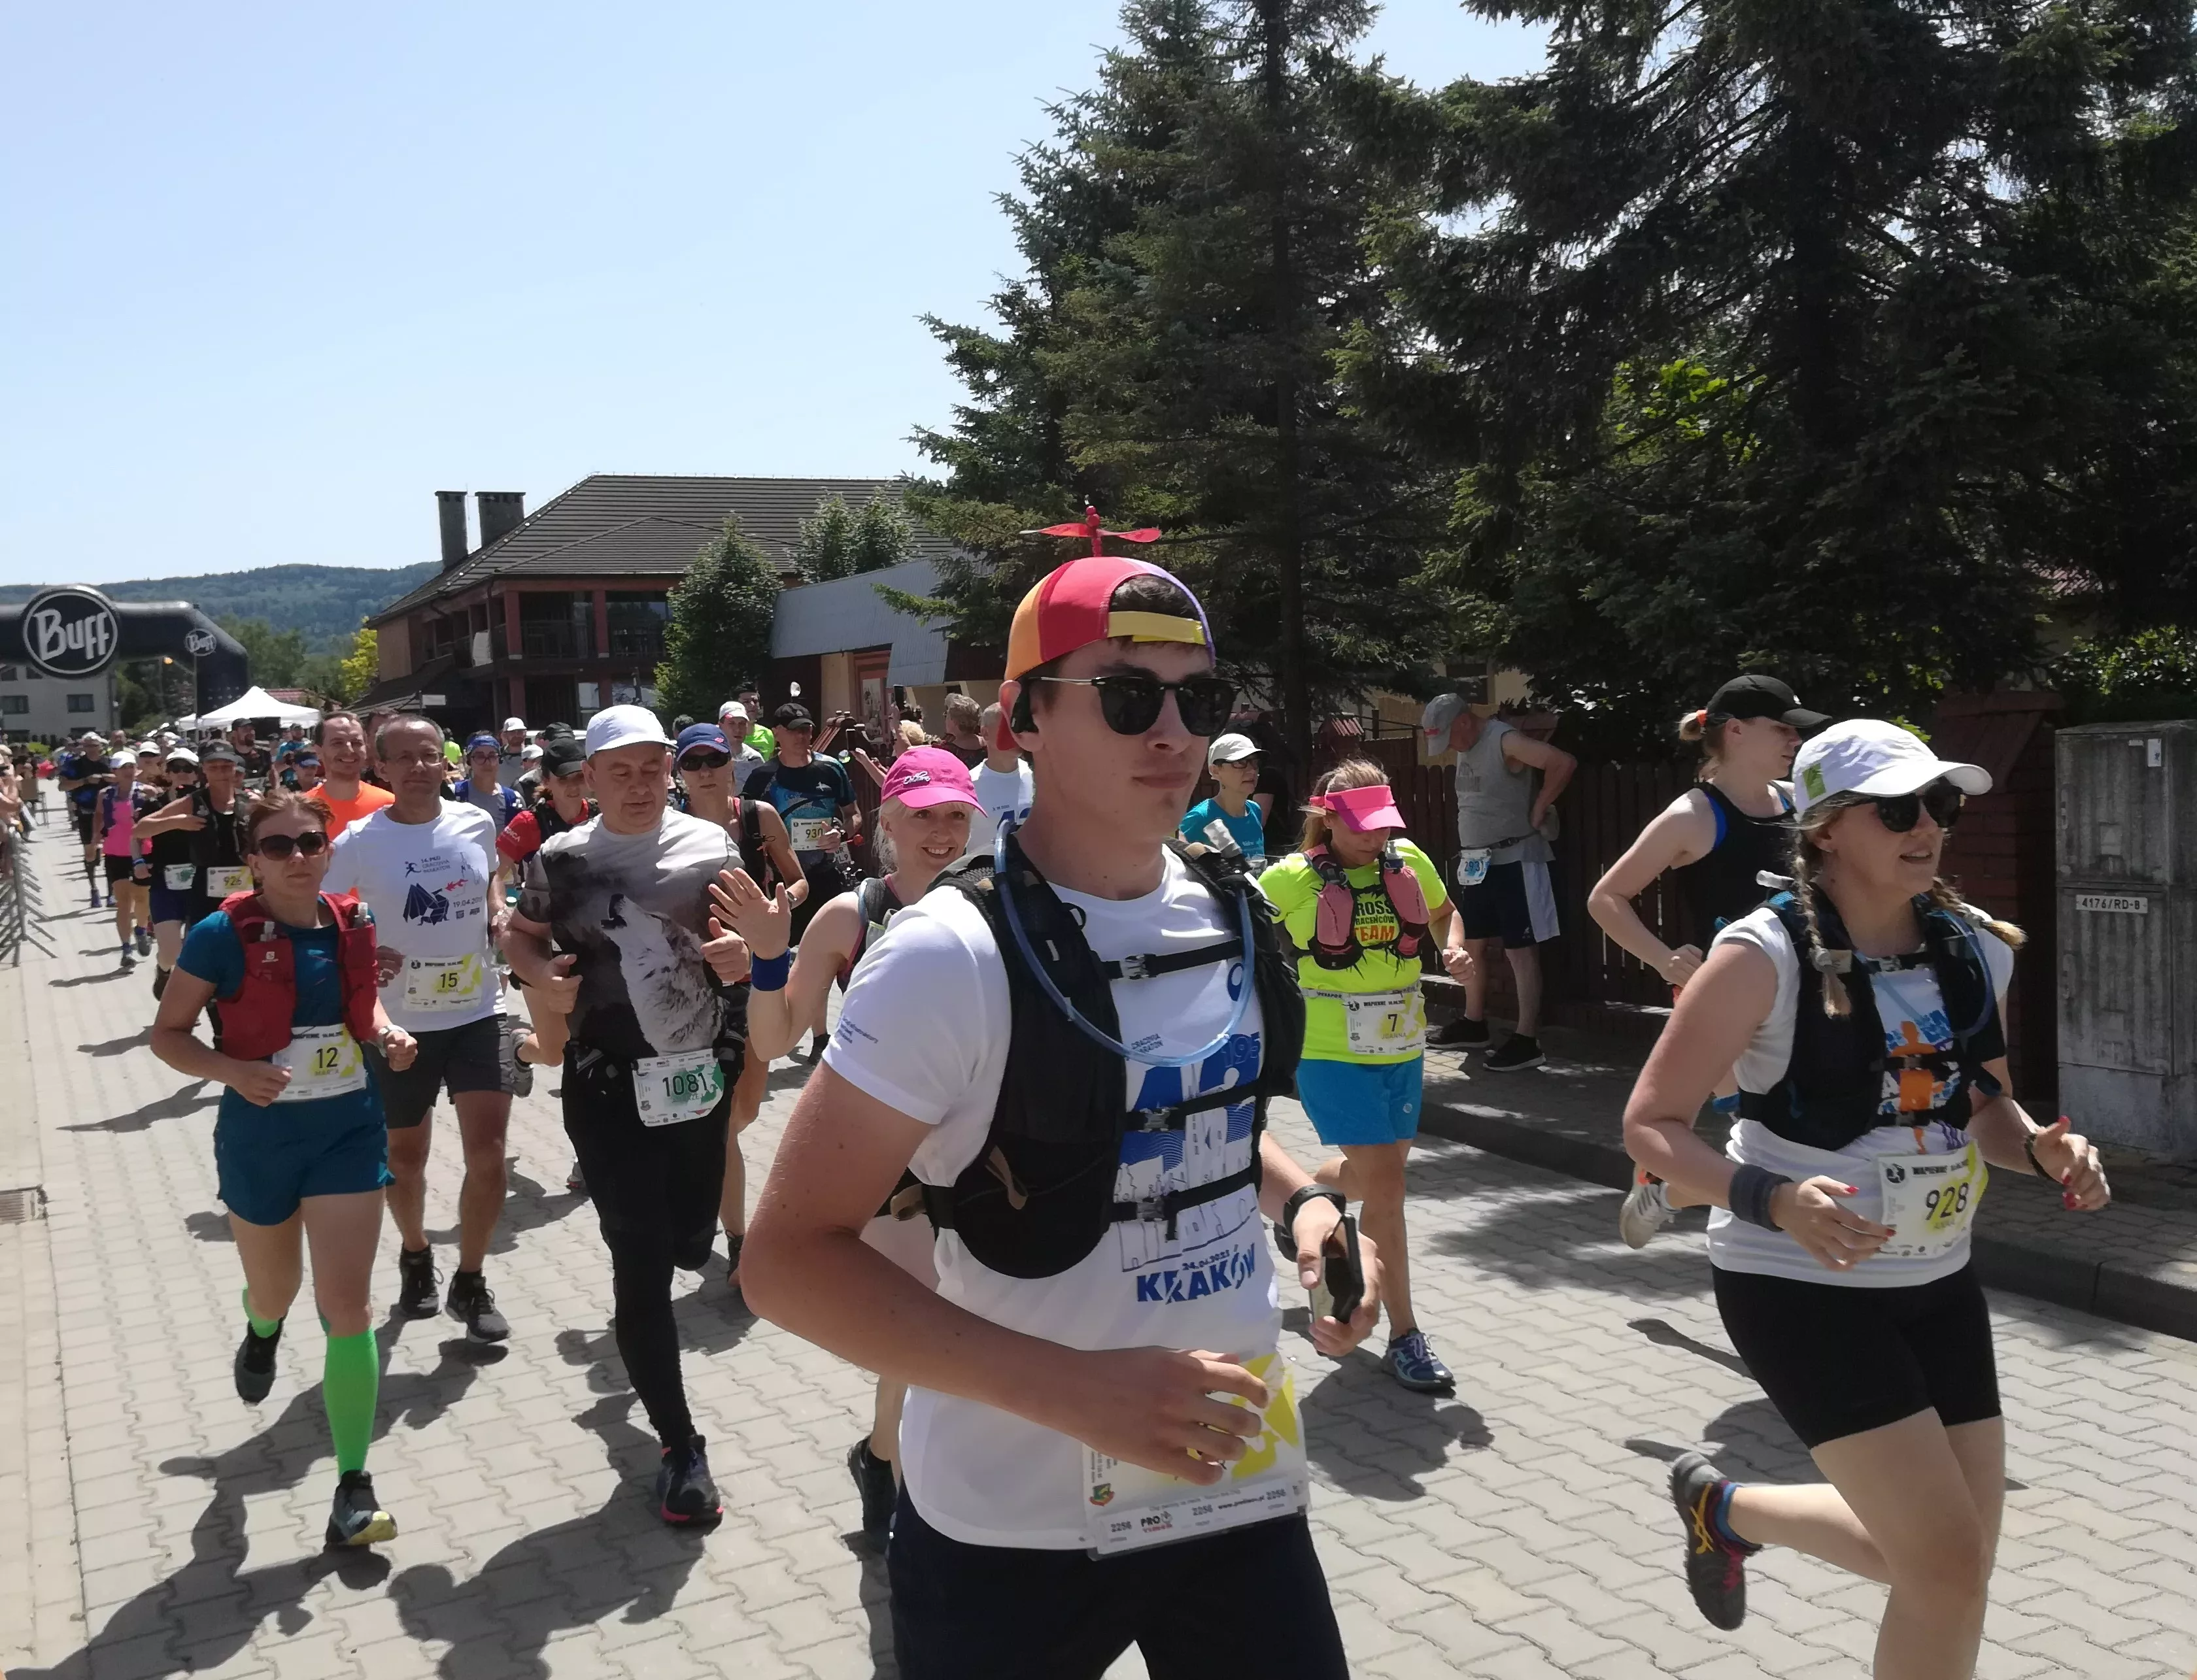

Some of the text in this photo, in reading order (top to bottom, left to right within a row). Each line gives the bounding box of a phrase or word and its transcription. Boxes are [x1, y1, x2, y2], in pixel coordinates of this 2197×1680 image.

[1356, 901, 1392, 916] ROSS
[440, 973, 458, 988] 15
[1388, 1013, 1398, 1032] 7
[1138, 1040, 1164, 1054] ARATON
[316, 1047, 338, 1069] 12
[662, 1073, 707, 1098] 1081
[1925, 1182, 1969, 1220] 928
[1136, 1242, 1255, 1305] KRAKÓW
[1140, 1515, 1160, 1527] PRO
